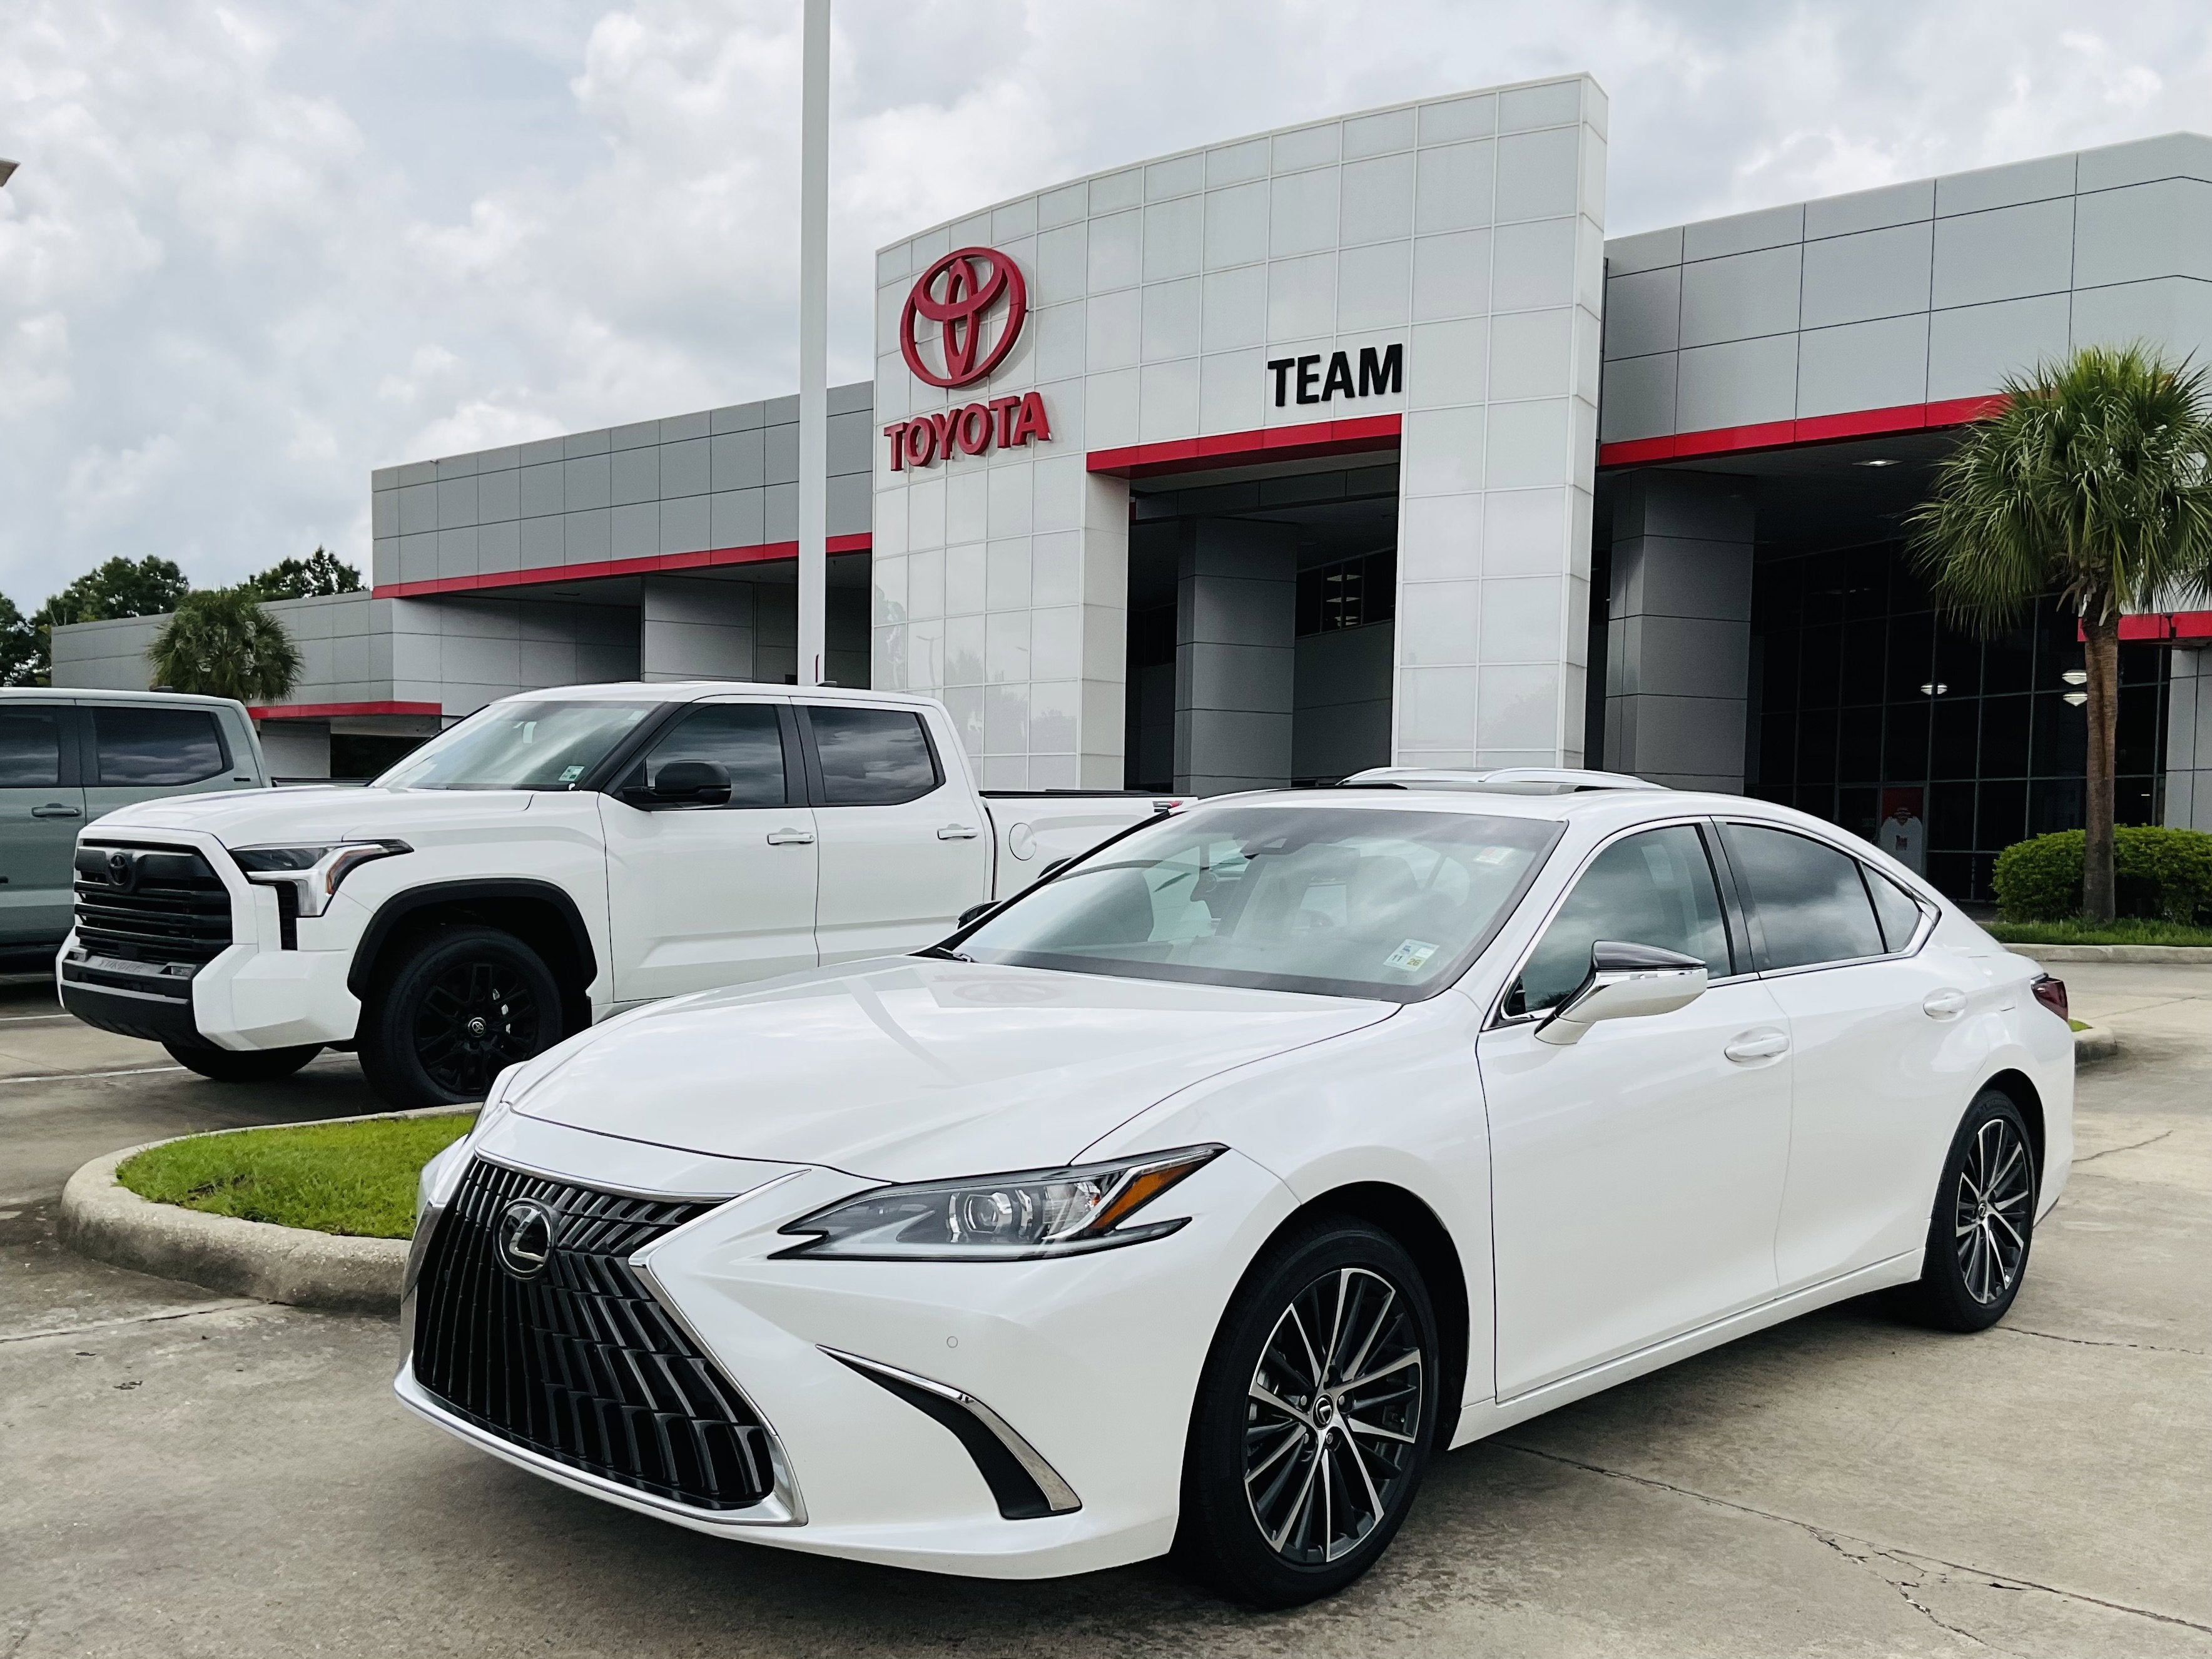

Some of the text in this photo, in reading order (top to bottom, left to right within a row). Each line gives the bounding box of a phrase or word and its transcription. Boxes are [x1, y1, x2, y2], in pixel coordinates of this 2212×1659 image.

[1267, 343, 1403, 407] TEAM
[884, 392, 1052, 471] TOYOTA
[1391, 954, 1403, 962] 11
[1406, 958, 1421, 966] 26
